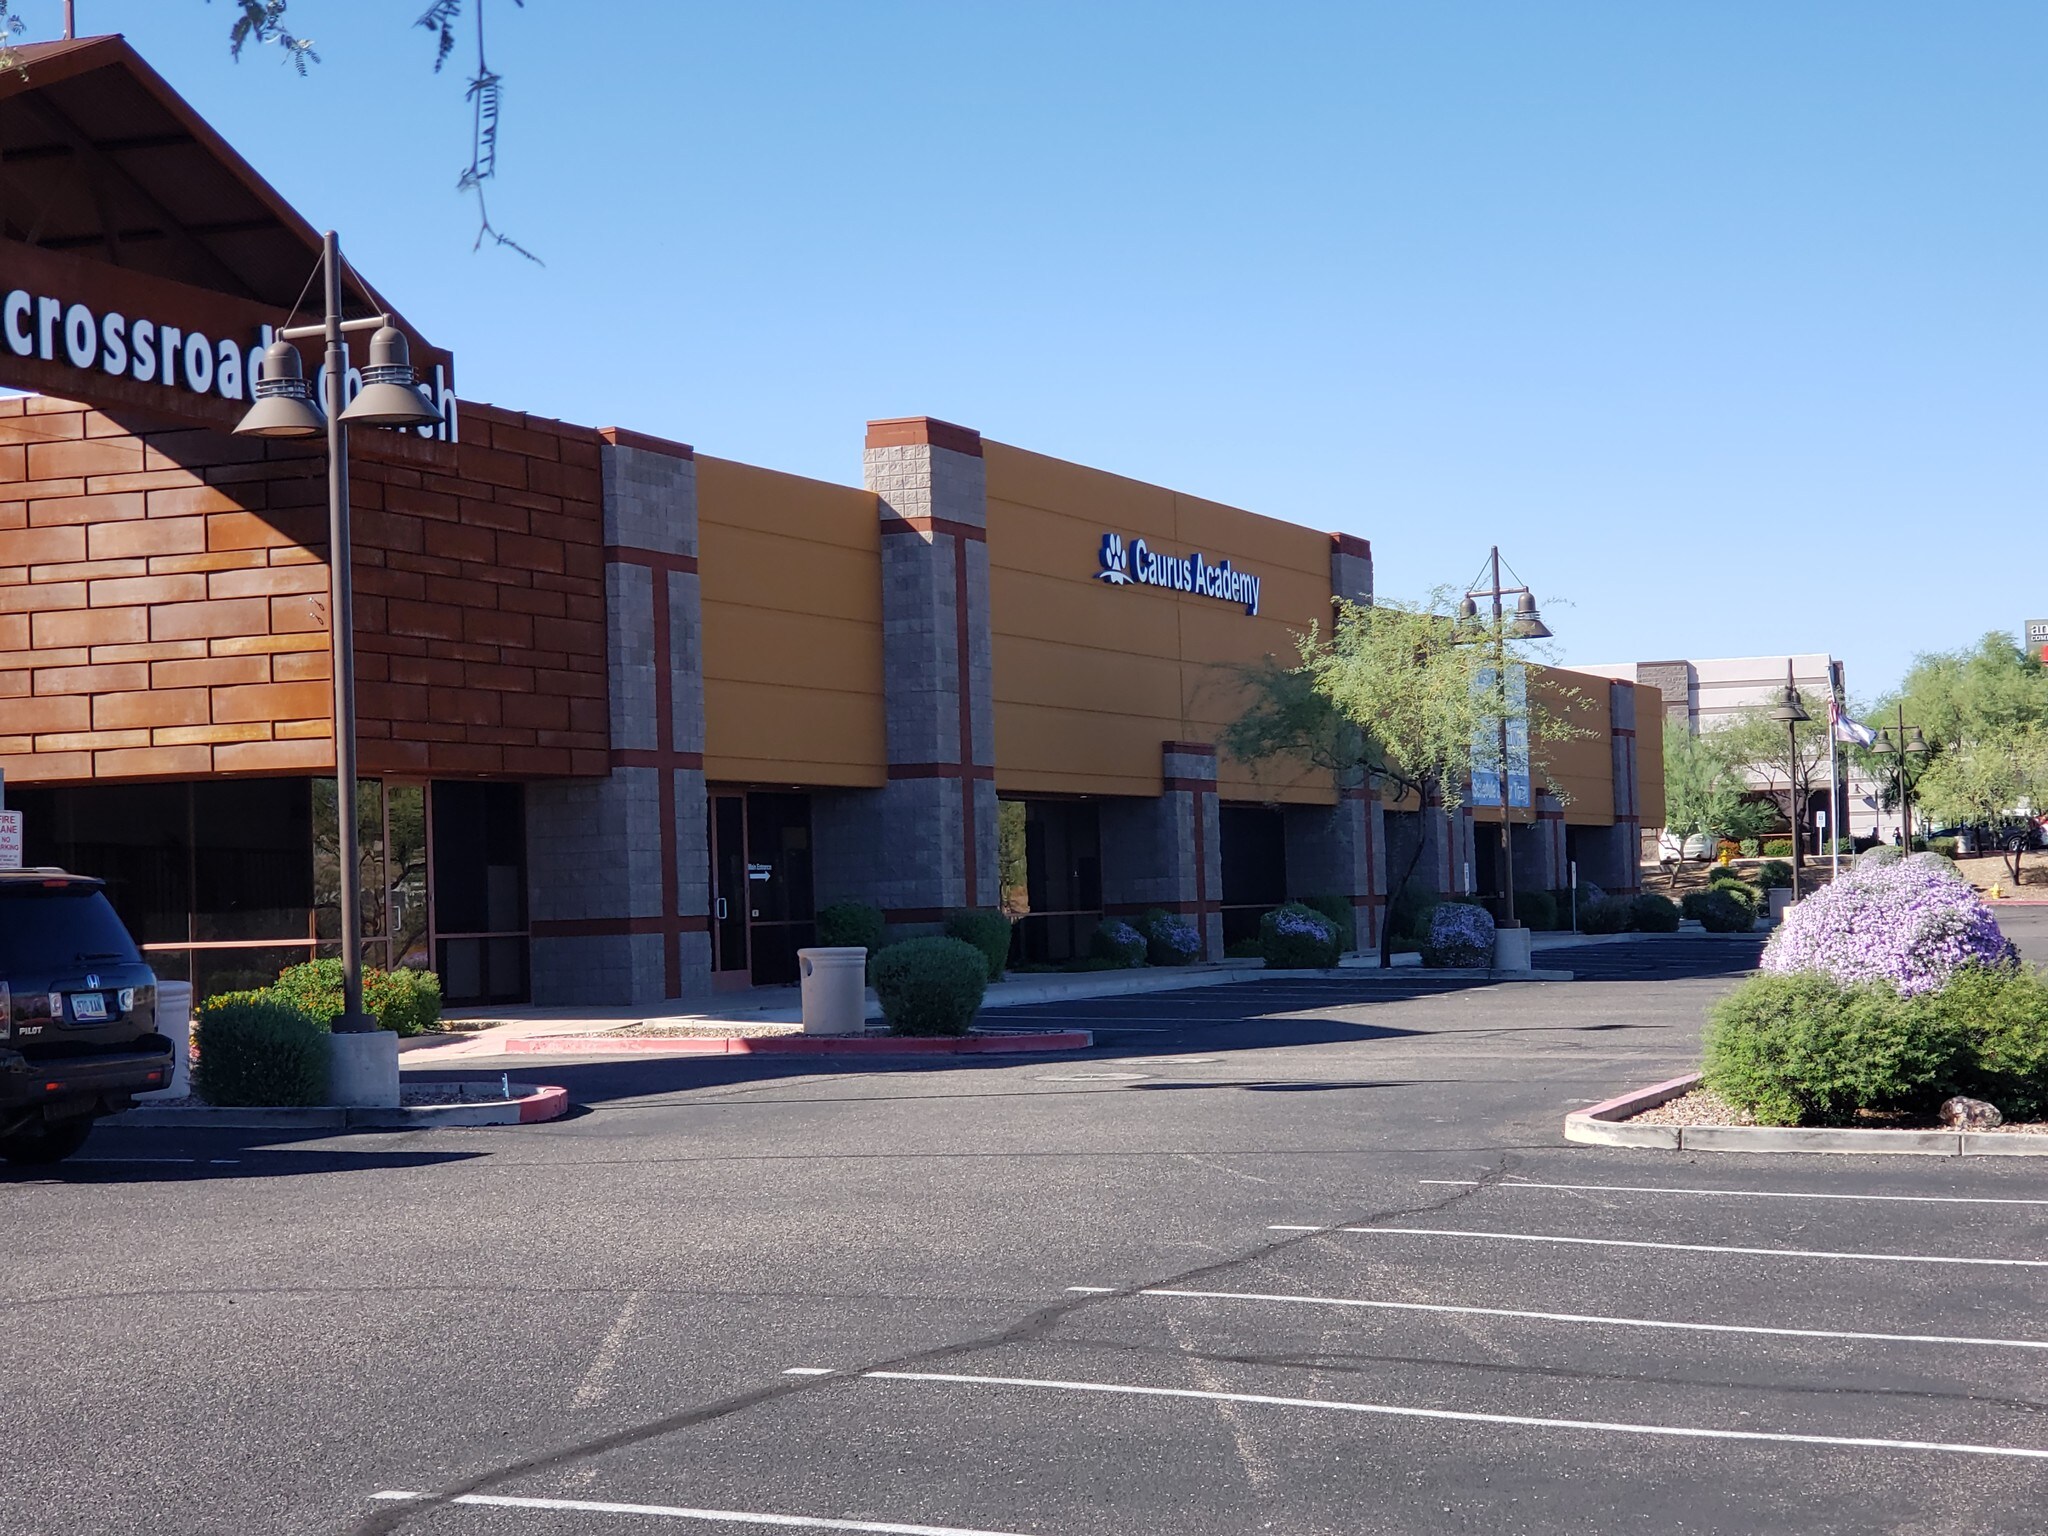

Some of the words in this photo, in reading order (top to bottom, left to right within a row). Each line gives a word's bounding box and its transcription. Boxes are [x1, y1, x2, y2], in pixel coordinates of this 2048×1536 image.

[3, 289, 303, 404] crossroad
[1133, 538, 1192, 592] Caurus
[1194, 552, 1261, 616] Academy
[0, 825, 18, 834] ANE
[19, 1025, 43, 1036] PILOT
